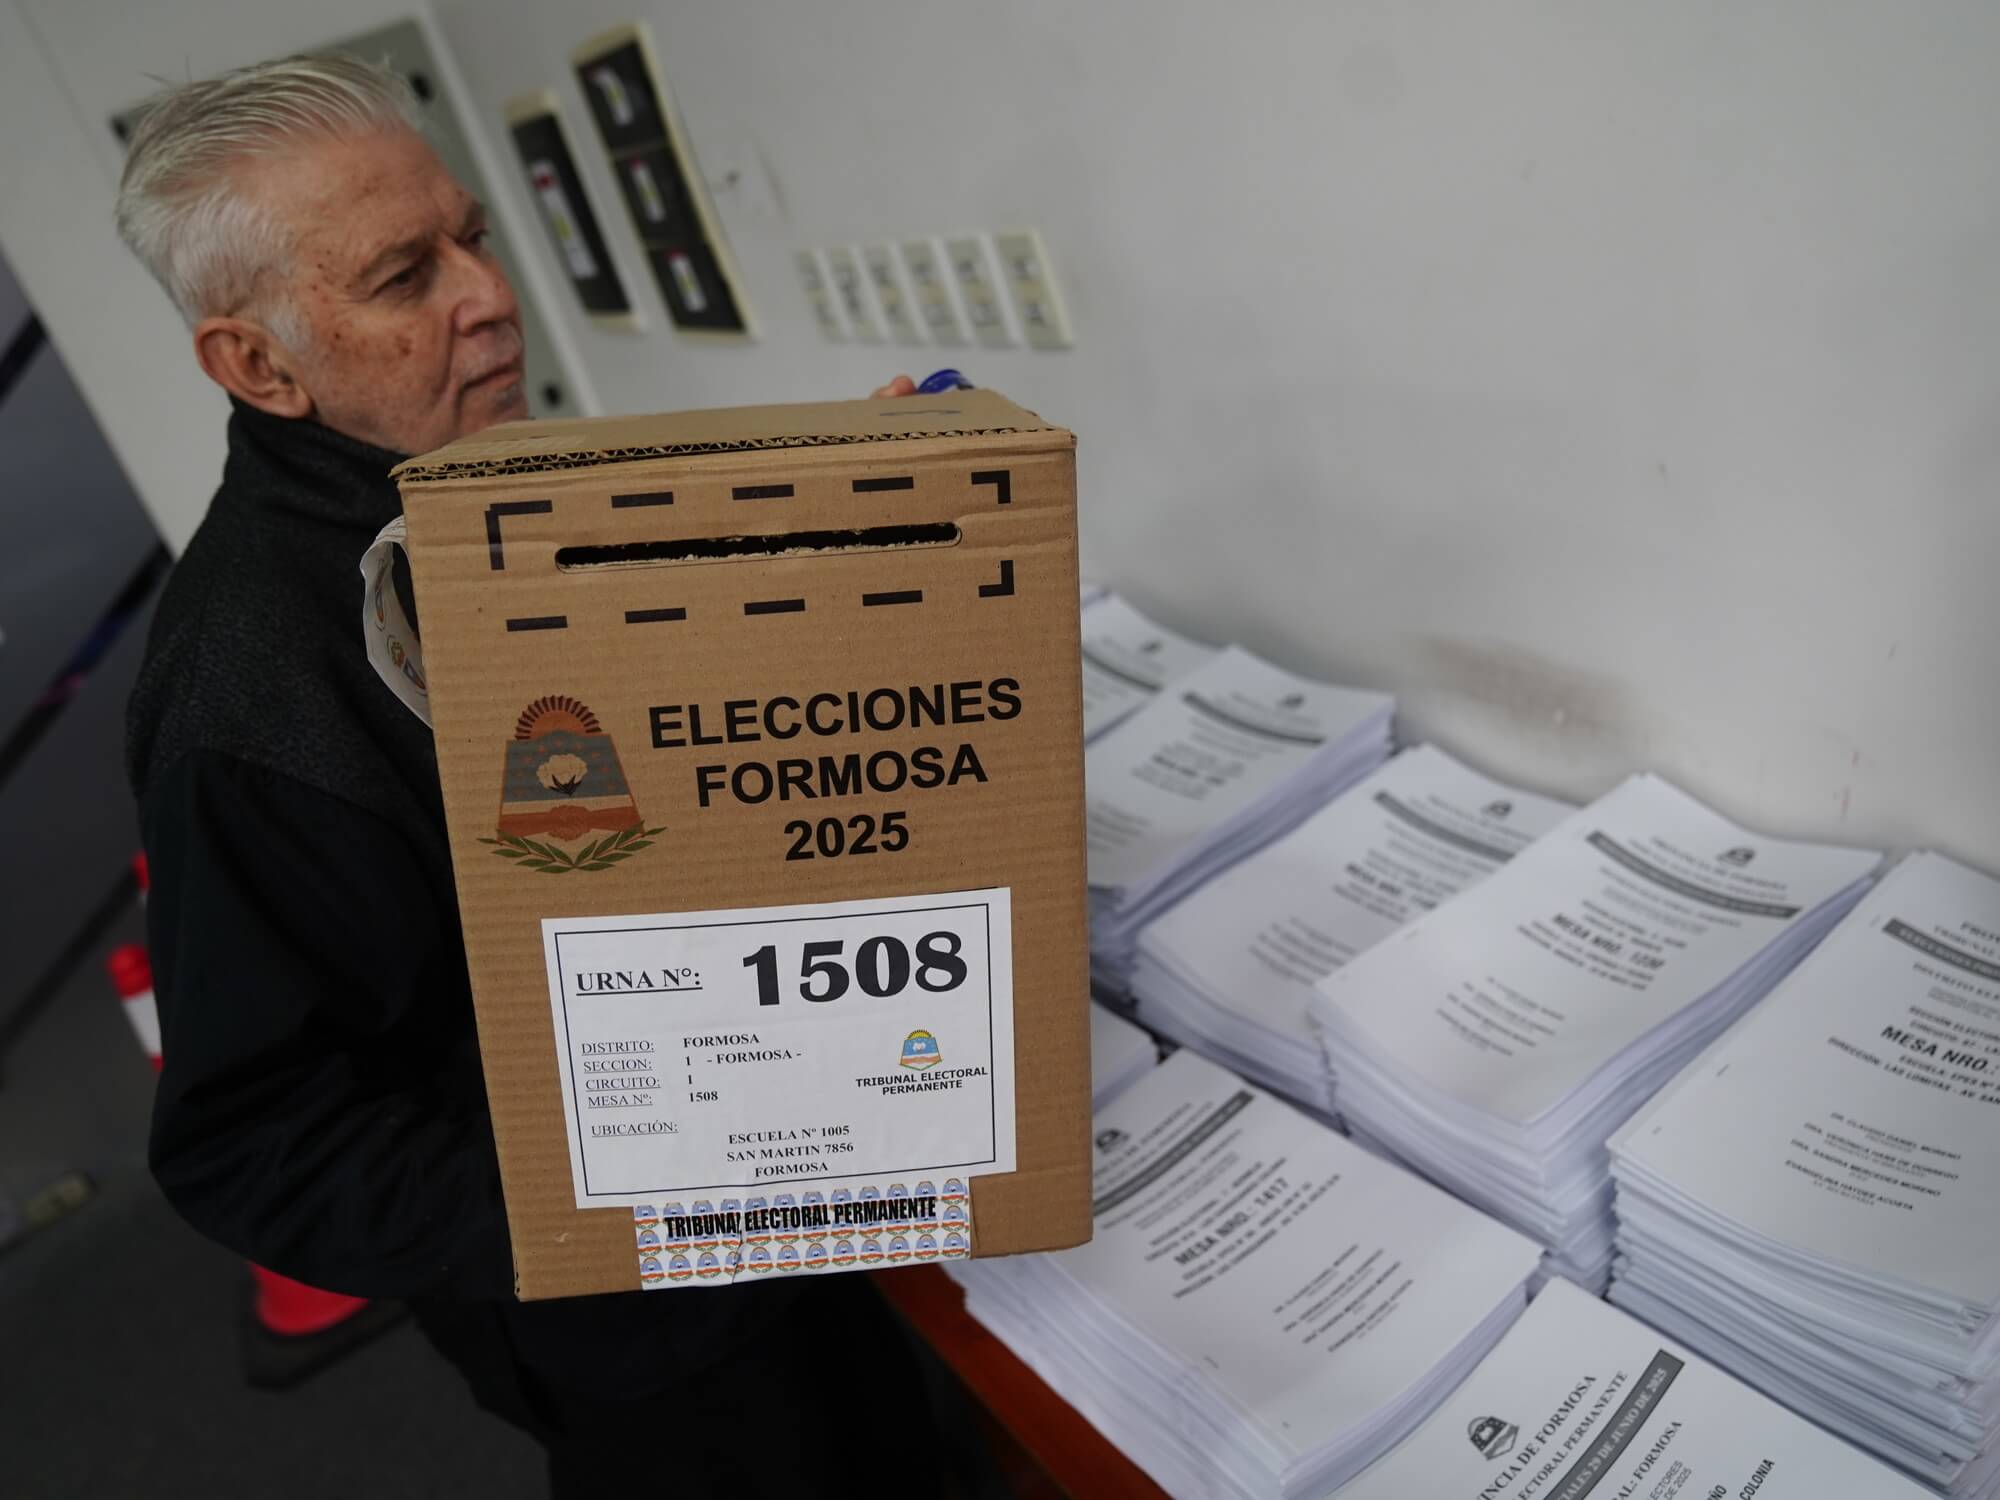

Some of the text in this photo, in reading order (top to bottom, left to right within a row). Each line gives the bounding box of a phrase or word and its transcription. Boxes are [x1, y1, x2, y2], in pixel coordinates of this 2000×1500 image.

[648, 677, 1022, 748] ELECCIONES
[696, 743, 988, 807] FORMOSA
[784, 811, 910, 860] 2025
[576, 969, 655, 992] URNA
[743, 931, 968, 1006] 1508
[581, 1033, 760, 1055] DISTRITO: FORMOSA
[1880, 1025, 1938, 1057] MESA
[584, 1059, 653, 1072] SECCION:
[685, 1055, 692, 1067] 1
[716, 1050, 792, 1065] FORMOSA
[856, 1067, 988, 1088] TRIBUNAL ELECTORAL
[585, 1074, 693, 1090] CIRCUITO: 1
[588, 1096, 629, 1107] MESA
[689, 1090, 719, 1102] 1508
[882, 1079, 963, 1095] PERMANENTE
[591, 1119, 679, 1136] UBICACIÓN:
[728, 1131, 797, 1145] ESCUELA
[821, 1125, 850, 1137] 1005
[727, 1142, 854, 1162] SAN MARTIN 7856
[754, 1162, 828, 1178] FORMOSA
[744, 1204, 831, 1232] ELECTORAL
[834, 1196, 936, 1225] PERMANENTE
[1478, 1375, 1597, 1500] INCIA DE FORMOSA
[1516, 1370, 1628, 1500] ECTORAL PERMANENTE
[1558, 1468, 1593, 1500] IALES
[1597, 1441, 1616, 1459] DE
[1611, 1408, 1640, 1445] JUNIO
[1634, 1390, 1652, 1410] DE
[1645, 1367, 1668, 1393] 2025
[1612, 1421, 1683, 1500] AL: FORMOSA
[1648, 1459, 1684, 1500] ECTORES
[1664, 1466, 1693, 1500] DE 2025
[1739, 1458, 1776, 1500] COLONIA
